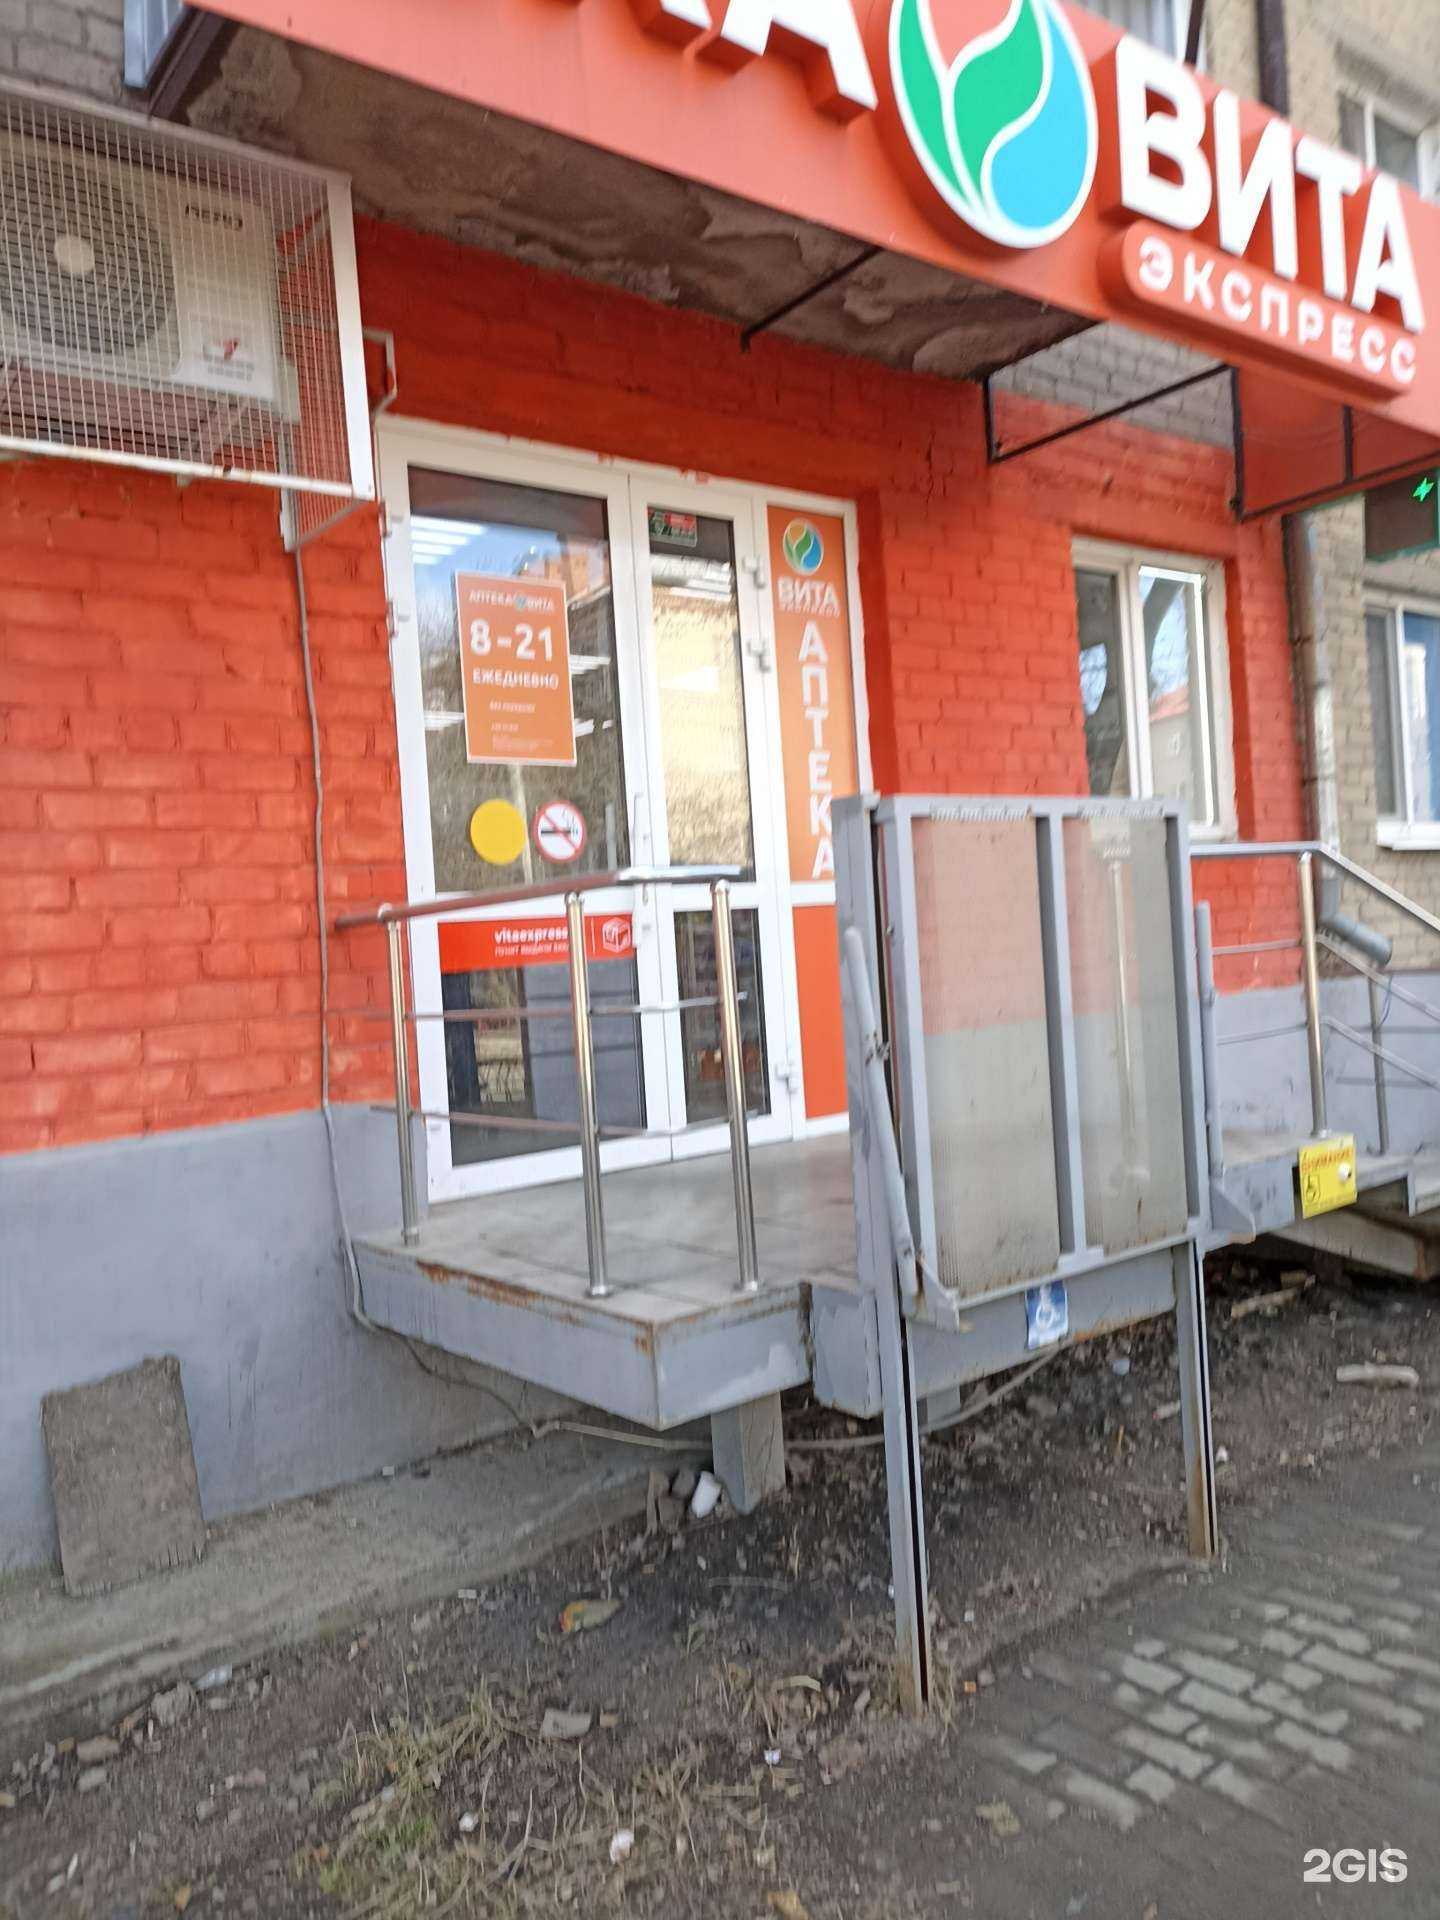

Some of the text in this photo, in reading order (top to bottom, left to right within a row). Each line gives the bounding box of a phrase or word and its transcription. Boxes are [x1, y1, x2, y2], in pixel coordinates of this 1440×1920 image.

[1115, 34, 1425, 335] ВИТА
[1138, 236, 1417, 384] ЭКСПРЕСС
[778, 576, 839, 611] ВИТА
[472, 666, 560, 689] ЕЖЕДНЕВНО
